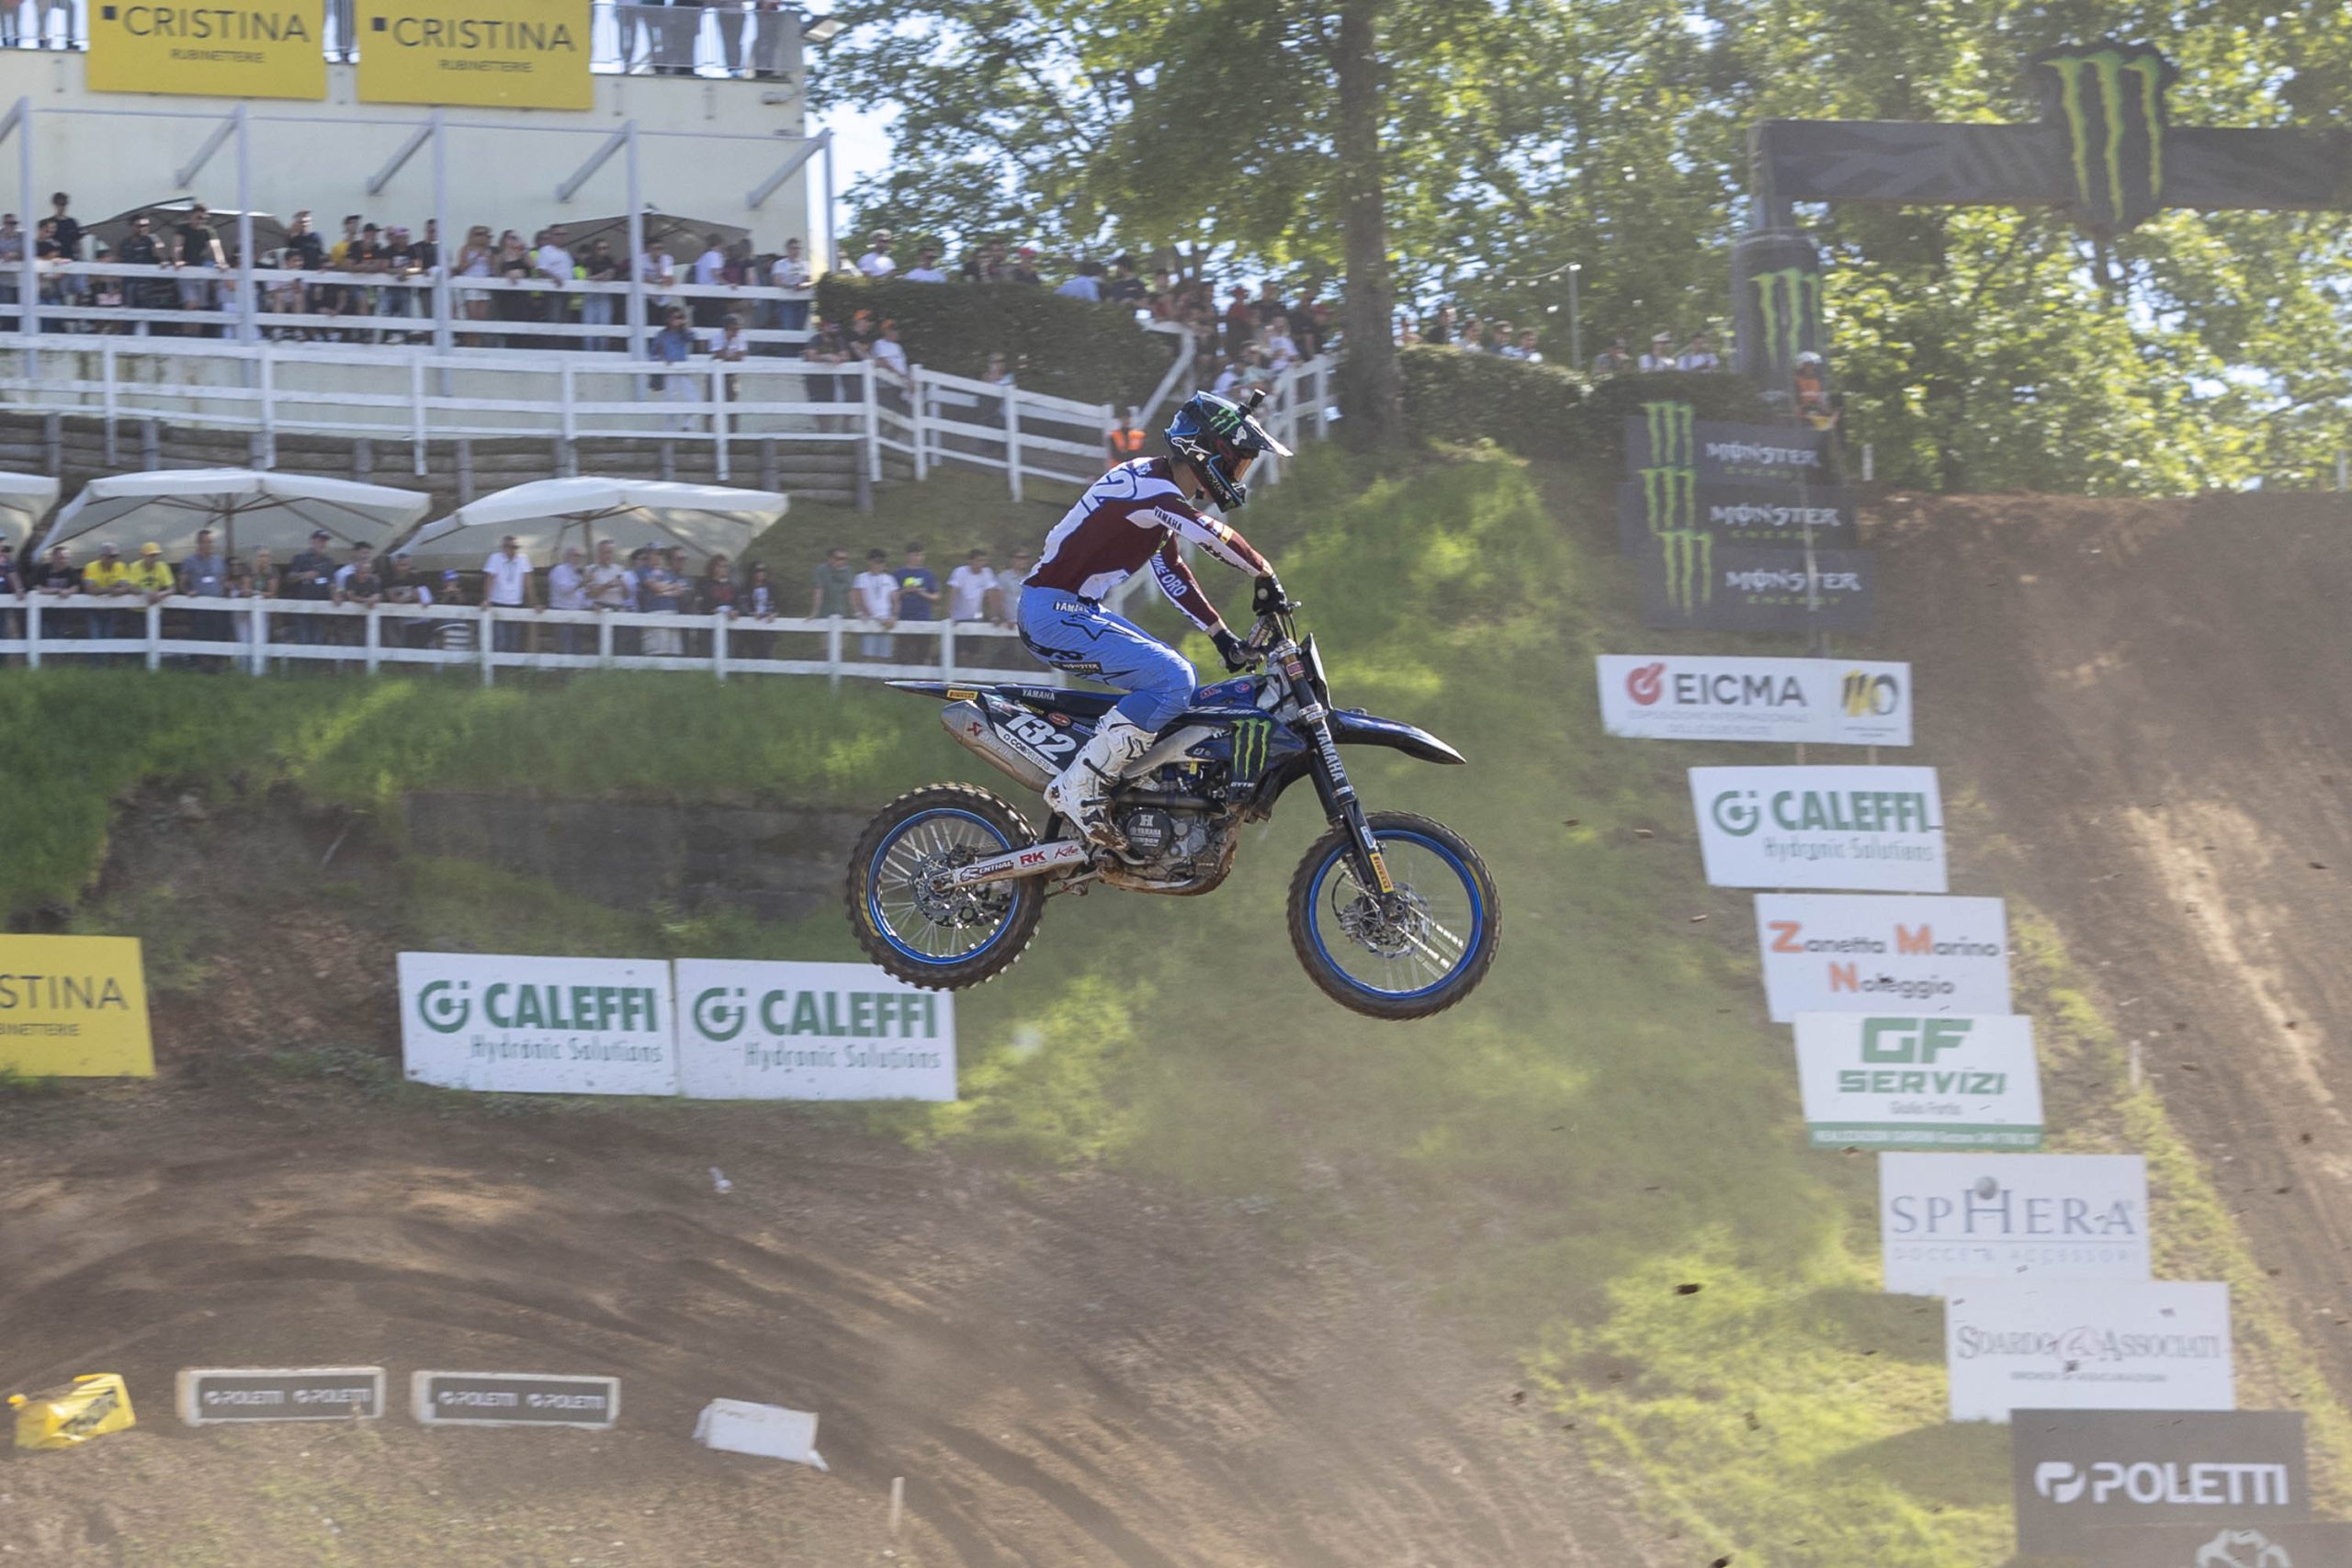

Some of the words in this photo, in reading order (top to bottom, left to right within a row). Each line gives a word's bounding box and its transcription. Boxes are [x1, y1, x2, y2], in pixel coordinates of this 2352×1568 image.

[123, 6, 311, 42] CRISTINA
[392, 17, 576, 51] CRISTINA
[1154, 508, 1182, 532] YAMAHA
[1711, 503, 1840, 526] MONSTER
[1161, 573, 1187, 597] ORO
[1022, 689, 1056, 701] YAMAHA
[1672, 673, 1808, 707] EICMA
[1005, 712, 1077, 761] 132
[1316, 728, 1344, 782] YAMAHA
[1771, 791, 1928, 832] CALEFFI
[1020, 851, 1046, 865] RK
[1768, 921, 1886, 953] Zanetta
[1895, 924, 2001, 956] Marino
[1828, 963, 1956, 998] Noleggio
[482, 982, 659, 1032] CALEFFI
[759, 989, 937, 1038] CALEFFI
[469, 1035, 560, 1064] Hydronic
[567, 1037, 662, 1063] Solutions
[743, 1043, 836, 1072] Hydronic
[842, 1044, 943, 1069] Solutions
[1861, 1018, 1973, 1064] GF
[1838, 1070, 2007, 1095] SERVIZI
[1890, 1189, 2136, 1235] SPHERA
[2092, 1462, 2290, 1504] POLETTI
